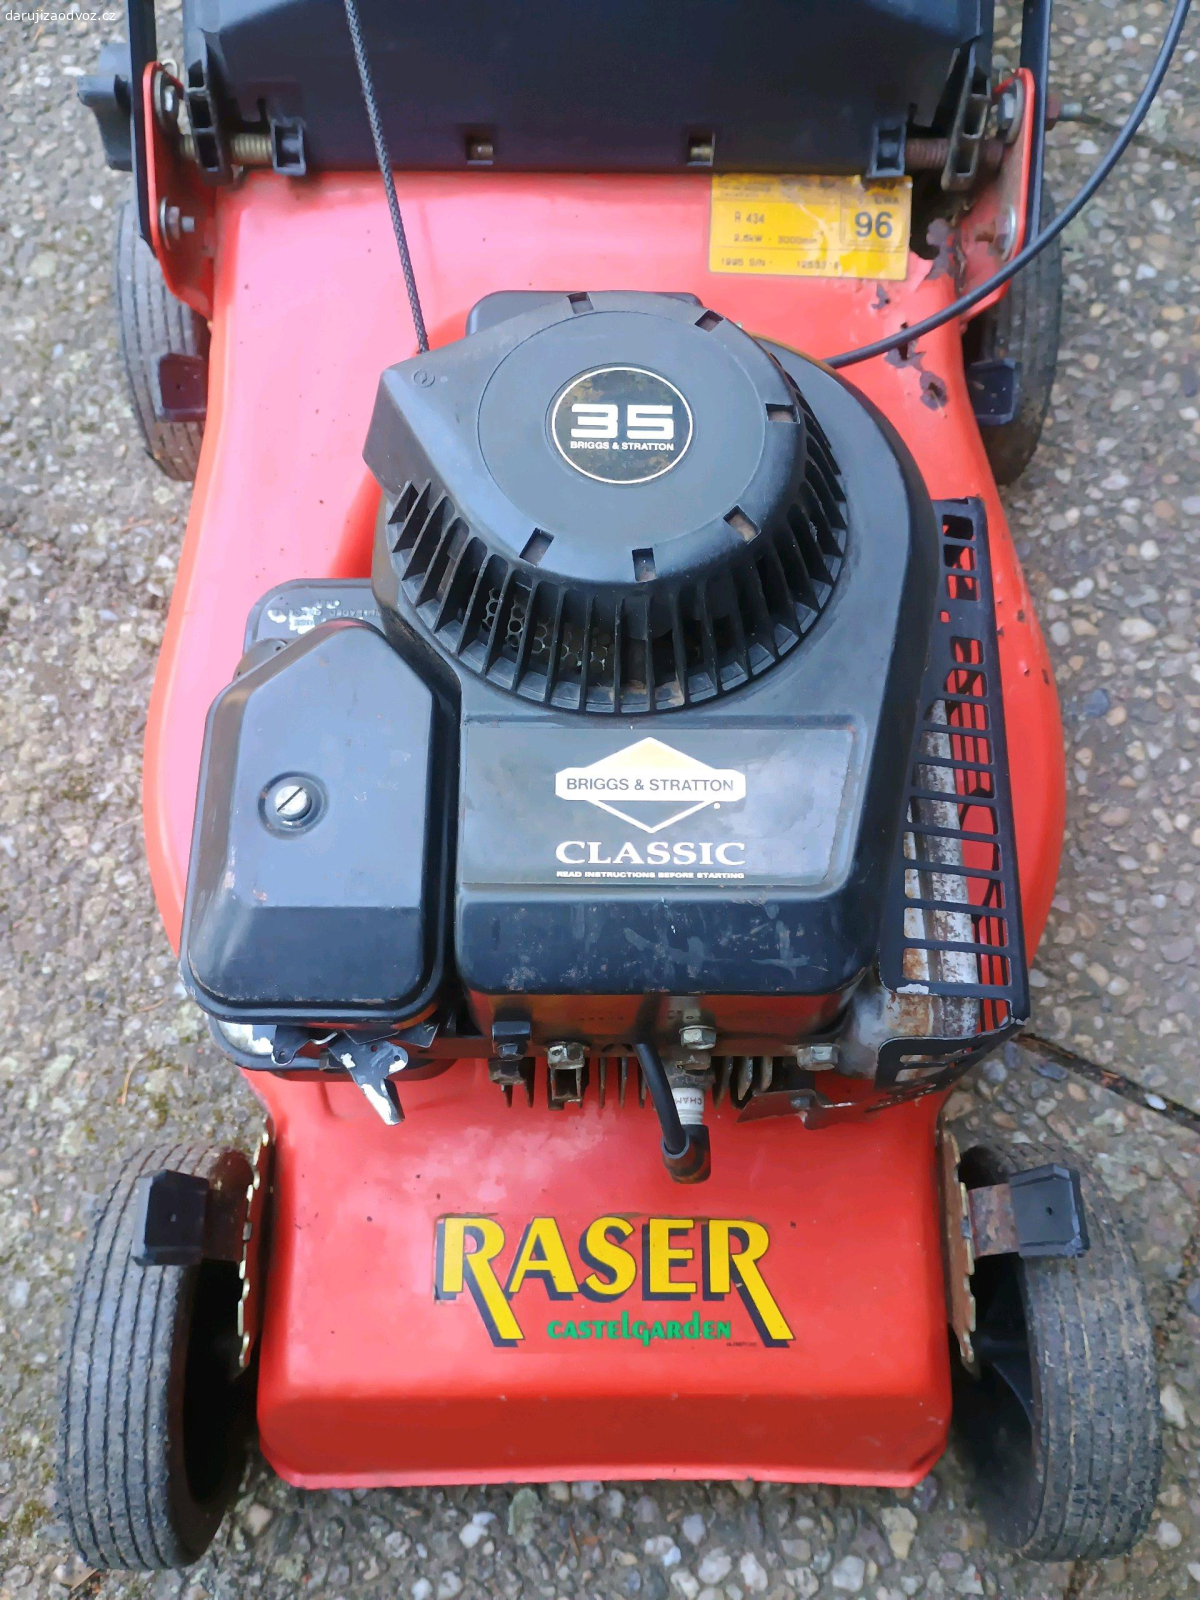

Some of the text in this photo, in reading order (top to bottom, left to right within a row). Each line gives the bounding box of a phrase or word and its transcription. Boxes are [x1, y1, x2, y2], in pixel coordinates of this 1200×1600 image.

[746, 213, 765, 224] 434
[854, 211, 893, 239] 96
[570, 403, 675, 440] 35
[570, 441, 674, 451] BRIGGS & STRATTON
[566, 778, 734, 792] BRIGGS & STRATTON
[555, 840, 746, 866] CLASSIC
[556, 870, 582, 878] READ
[584, 870, 656, 879] INSTRUCTIONS
[658, 871, 694, 879] BEFORE
[436, 1217, 795, 1348] RASER
